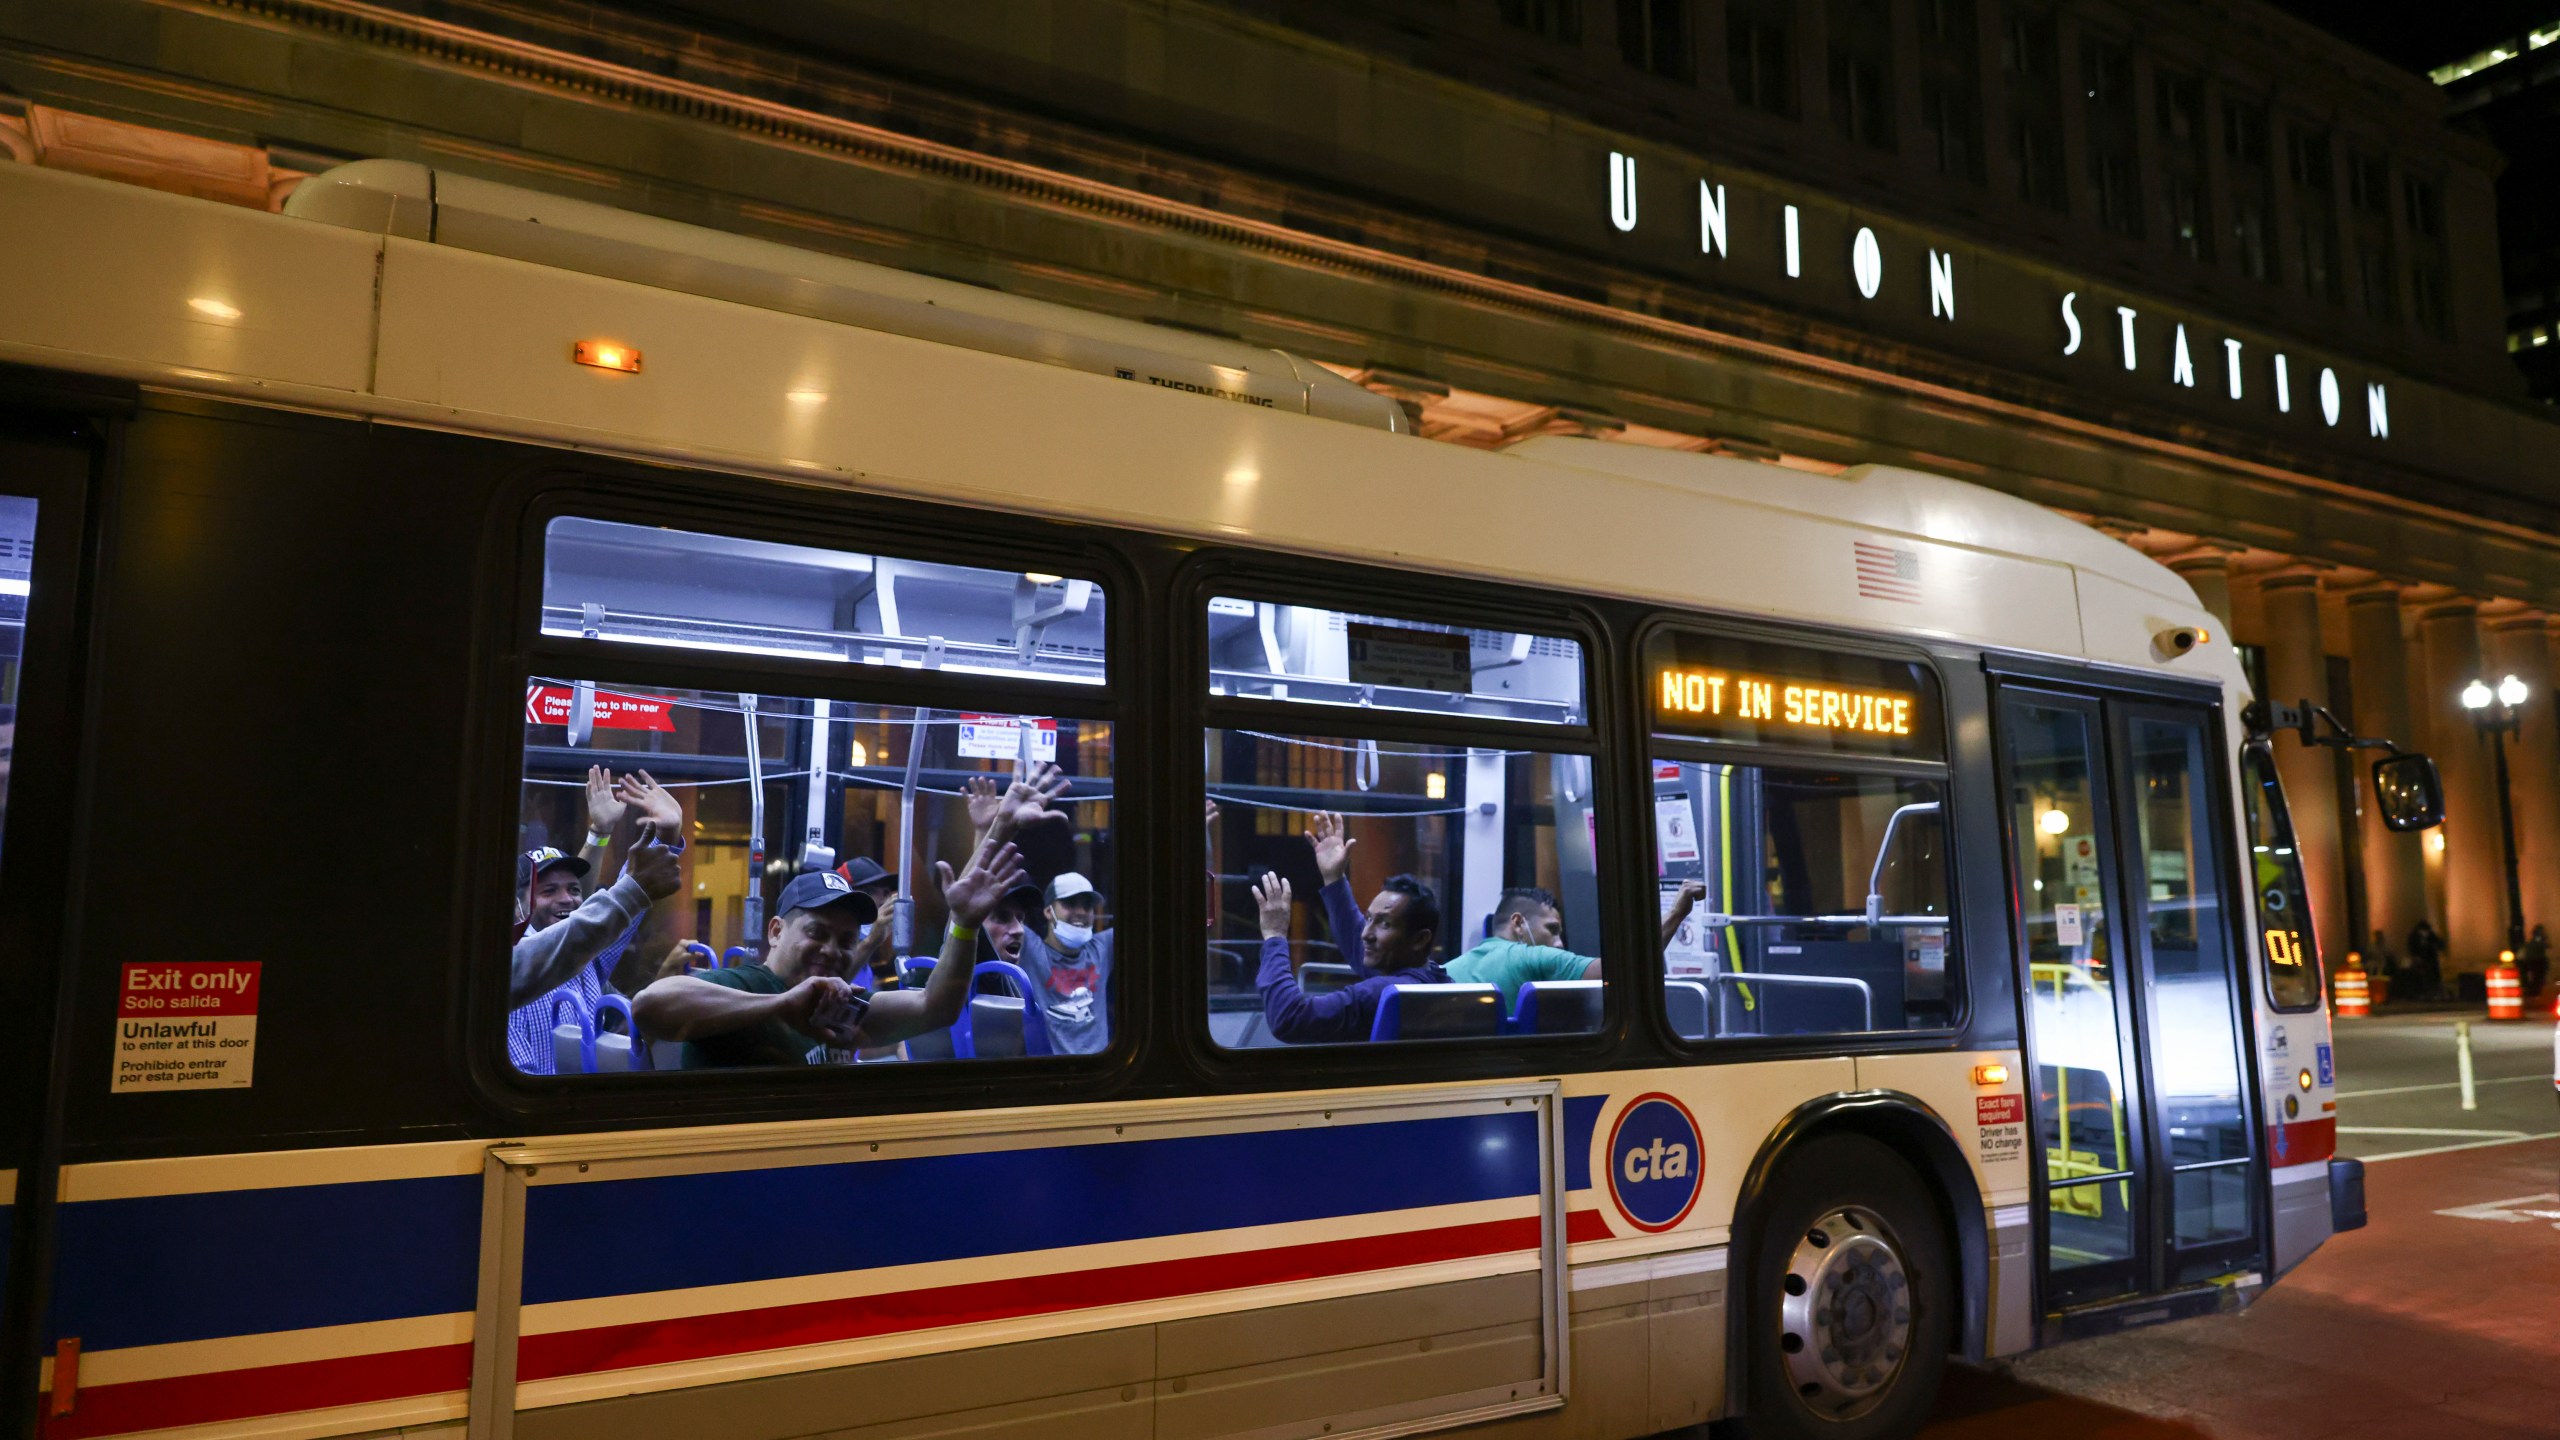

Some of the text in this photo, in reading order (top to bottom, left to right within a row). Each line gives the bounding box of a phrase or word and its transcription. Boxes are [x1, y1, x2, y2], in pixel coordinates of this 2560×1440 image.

[1610, 151, 2390, 441] UNION STATION
[610, 702, 620, 710] to
[622, 702, 637, 711] the
[640, 704, 659, 713] rear
[1663, 671, 1909, 735] NOT IN SERVICE
[544, 706, 563, 716] Use
[128, 968, 252, 994] Exit only
[125, 995, 221, 1009] Solo salida
[123, 1021, 216, 1039] Unlawful
[123, 1038, 249, 1051] to enter at this door
[121, 1059, 227, 1071] Prohibido entrar
[120, 1070, 219, 1085] por esta puerta
[1979, 1097, 2016, 1109] Exact fare
[1979, 1110, 2010, 1122] required
[1980, 1126, 2017, 1138] Driver has
[1981, 1138, 2021, 1149] NO change
[1624, 1137, 1688, 1183] cta
